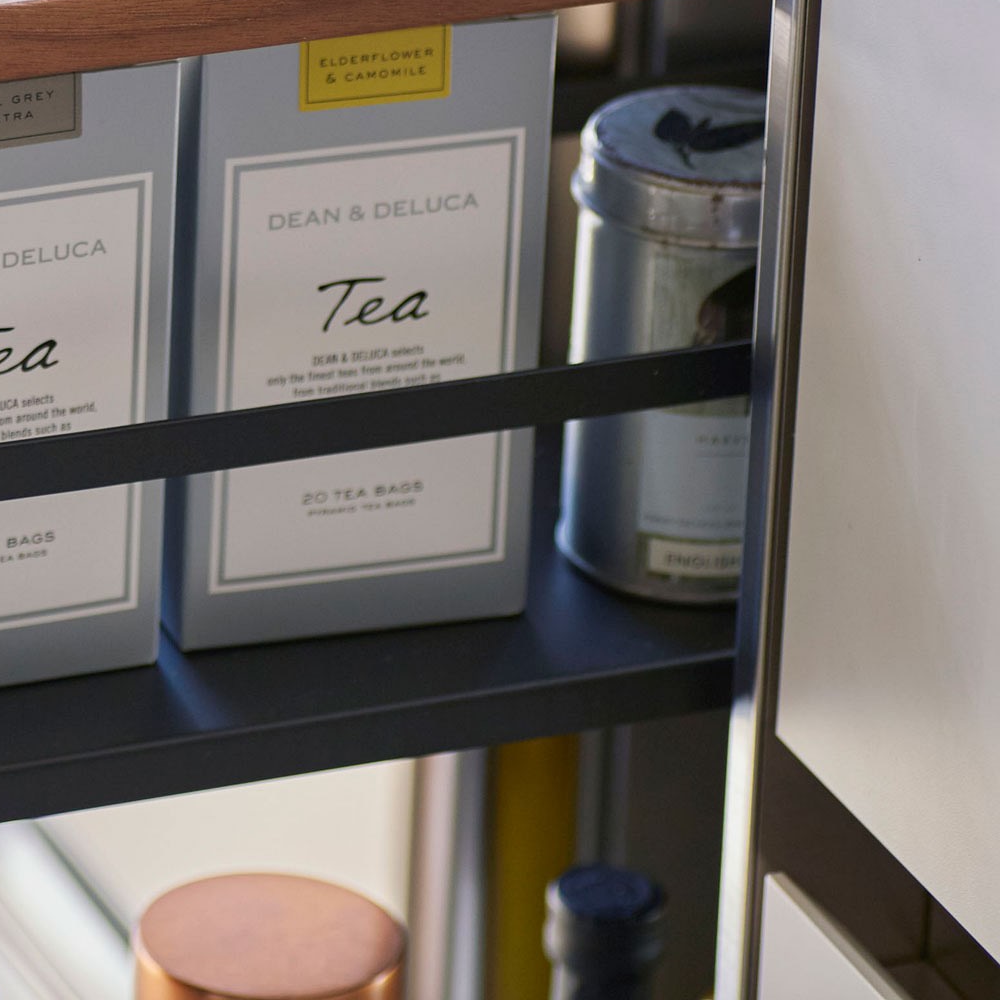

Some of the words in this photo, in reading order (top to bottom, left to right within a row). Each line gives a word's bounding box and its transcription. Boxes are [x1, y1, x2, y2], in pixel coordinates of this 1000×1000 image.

[319, 47, 434, 69] ELDERFLOWER
[326, 73, 336, 84] &
[344, 66, 427, 83] CAMOMILE
[11, 90, 55, 104] GREY
[268, 208, 341, 231] DEAN
[349, 205, 365, 222] &
[374, 193, 480, 220] DELUCA
[2, 239, 107, 269] DELUCA
[317, 277, 430, 332] Tea
[312, 355, 338, 367] DEAN
[341, 352, 349, 364] &
[352, 348, 389, 362] DELUCA
[22, 394, 55, 409] selects
[16, 410, 49, 426] around
[52, 406, 66, 418] the
[1, 426, 32, 441] blends
[35, 422, 58, 436] such
[60, 421, 72, 431] as
[302, 490, 328, 505] 20
[333, 487, 367, 501] TEA
[374, 480, 424, 497] BAGS
[7, 531, 56, 549] BAGS
[18, 550, 48, 561] BAGS
